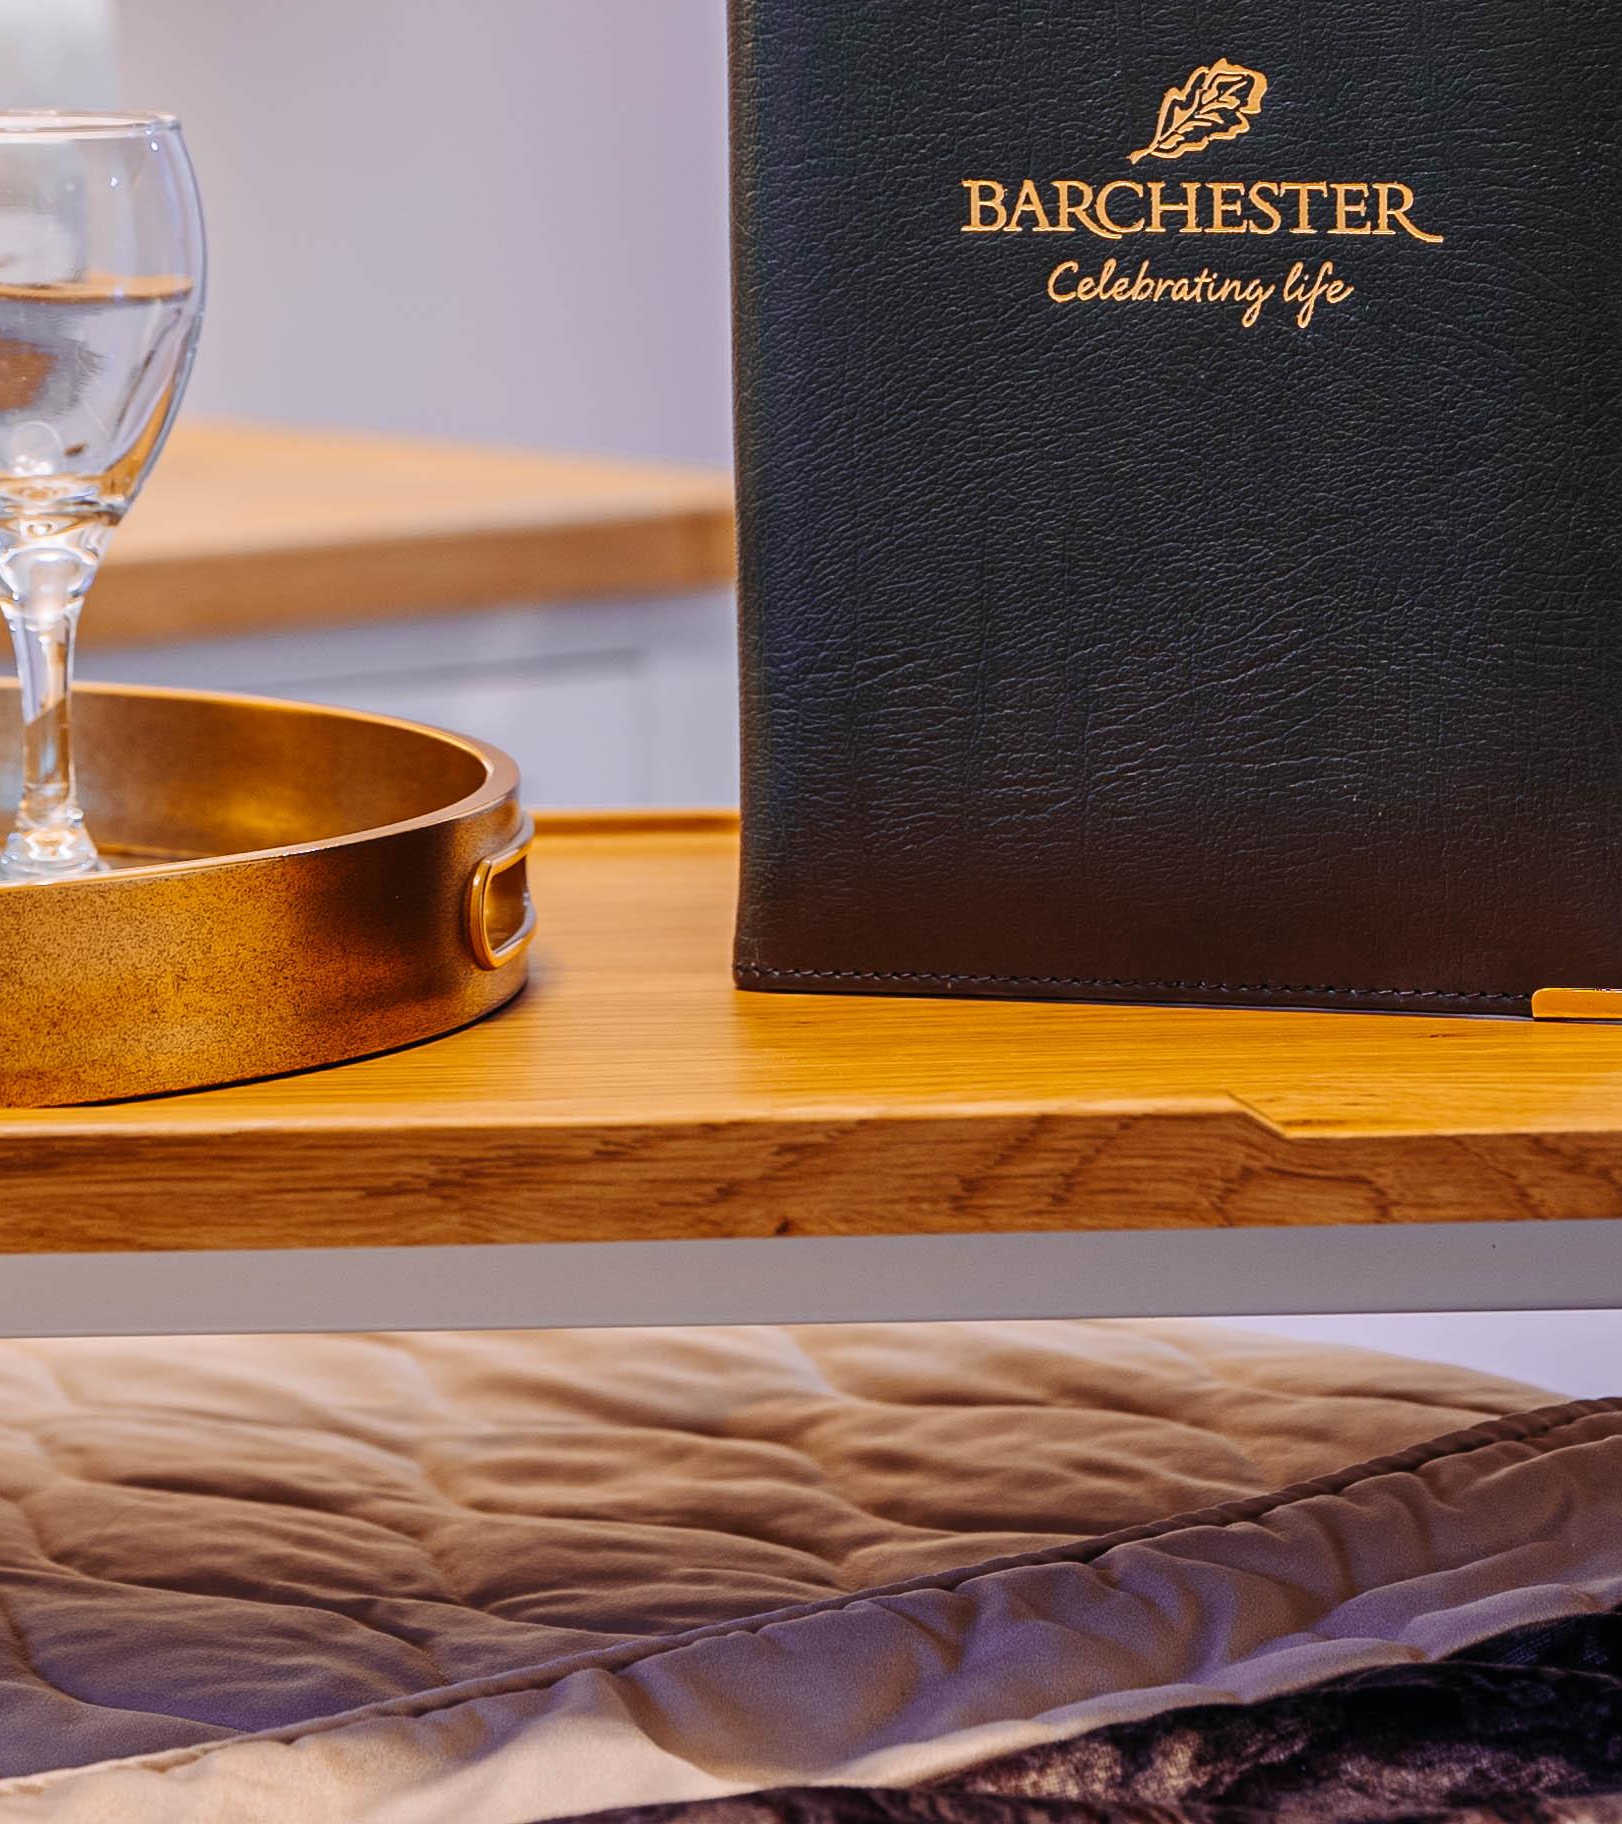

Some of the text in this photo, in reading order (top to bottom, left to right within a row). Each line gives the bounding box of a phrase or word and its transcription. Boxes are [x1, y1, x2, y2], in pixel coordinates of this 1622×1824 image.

[961, 178, 1444, 243] BARCHESTER
[1047, 258, 1356, 329] Celebrating life
